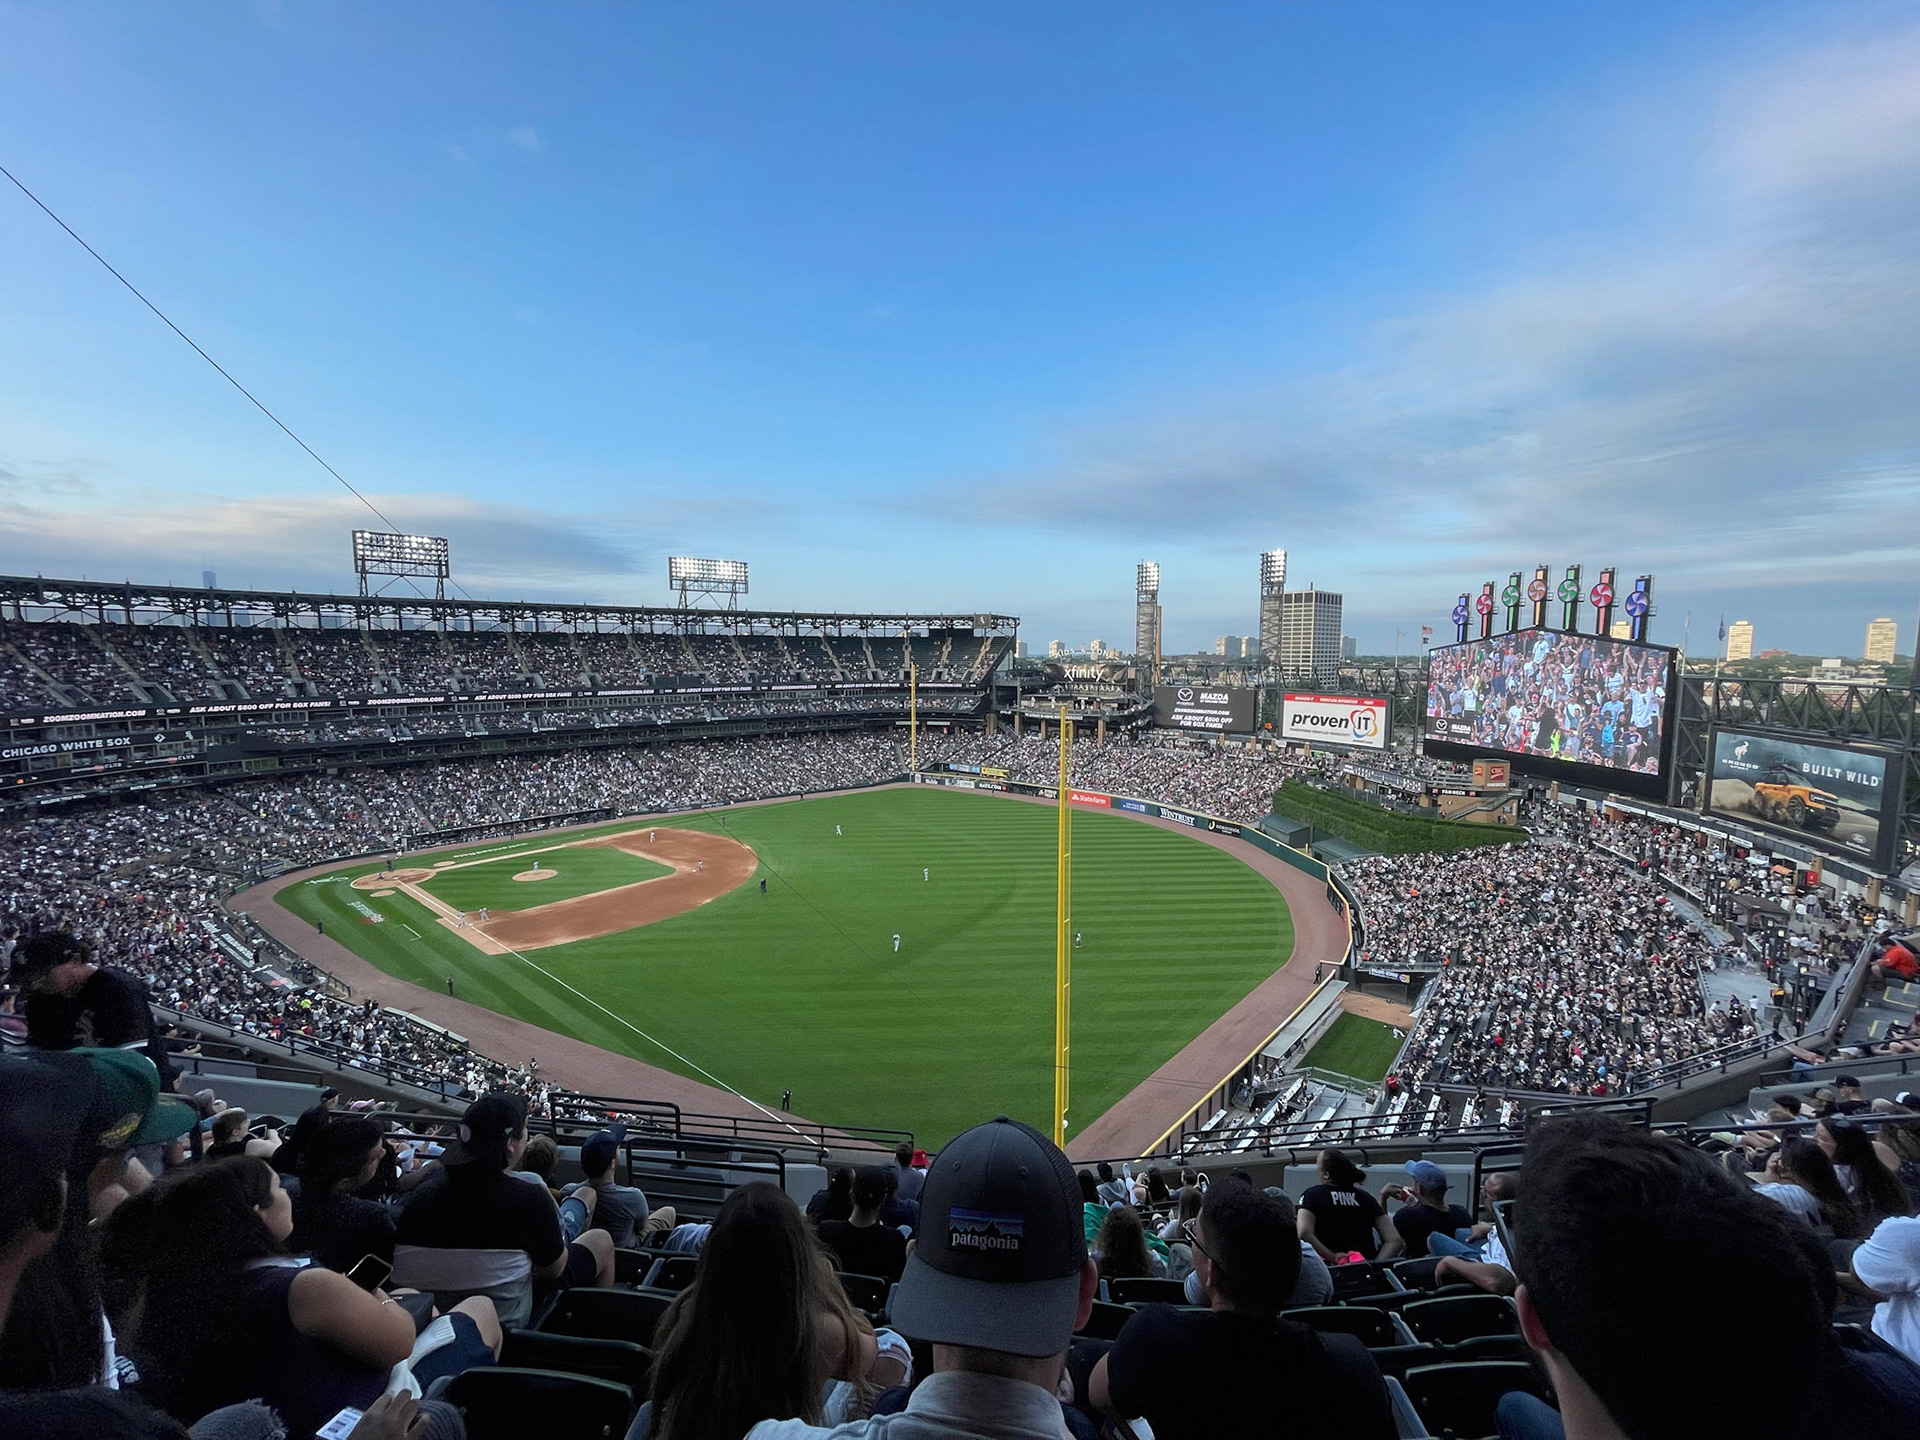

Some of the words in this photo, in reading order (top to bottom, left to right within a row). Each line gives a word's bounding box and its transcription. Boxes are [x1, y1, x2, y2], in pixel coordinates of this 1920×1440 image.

[1064, 665, 1104, 682] xfinity
[43, 710, 146, 723] ZOOMZOOMNATION.COM
[1291, 714, 1349, 728] proven
[1358, 717, 1371, 730] IT
[2, 744, 57, 758] CHICAGO
[61, 740, 103, 751] WHITE
[107, 737, 131, 746] SOX
[1722, 759, 1758, 769] BRONCO
[1803, 763, 1841, 778] BUILT
[1846, 771, 1878, 786] WILD
[1160, 808, 1195, 824] WINTRUST
[1331, 1191, 1360, 1206] PINK
[952, 1233, 1019, 1250] patagonia
